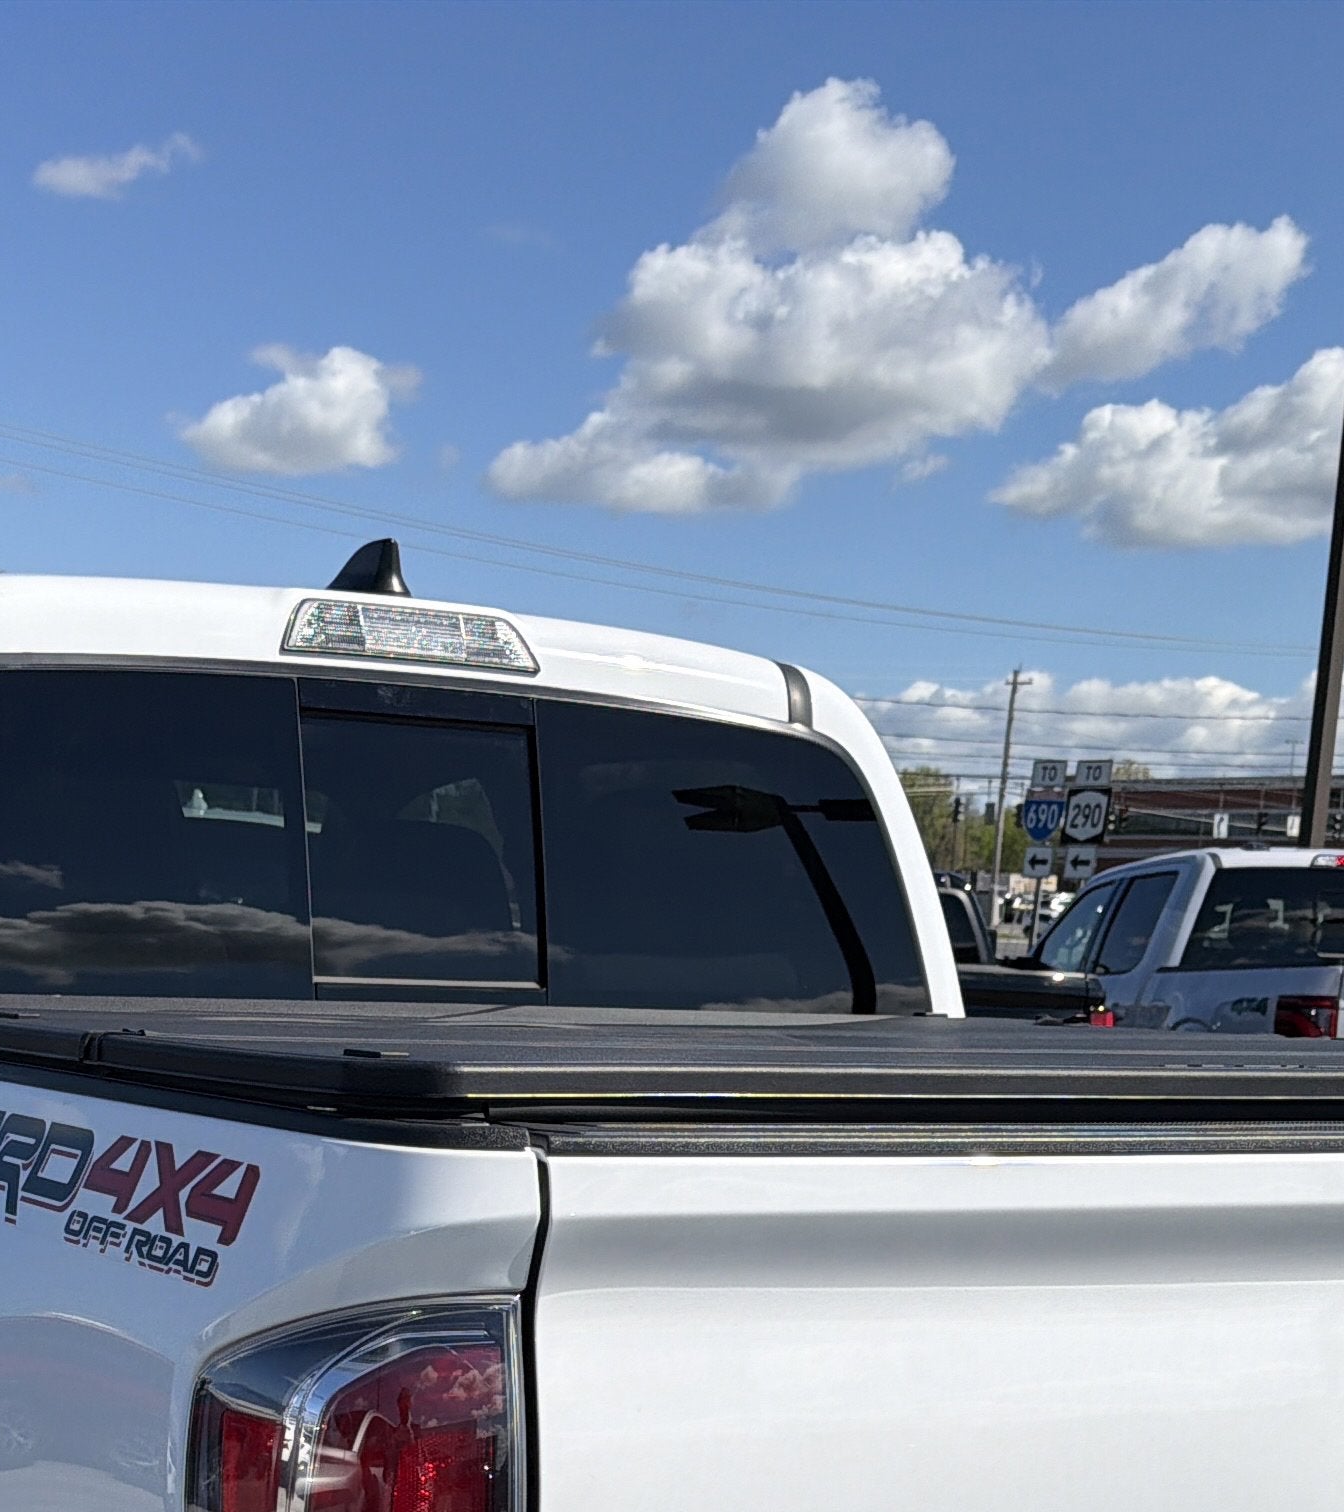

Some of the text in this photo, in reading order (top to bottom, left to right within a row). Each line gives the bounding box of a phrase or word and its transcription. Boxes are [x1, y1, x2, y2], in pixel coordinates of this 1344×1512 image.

[1041, 764, 1058, 782] TO
[1086, 764, 1103, 782] TO
[1026, 803, 1059, 830] 690
[1069, 803, 1103, 829] 290
[83, 1135, 260, 1247] 4X4
[63, 1209, 219, 1288] OFF ROAD
